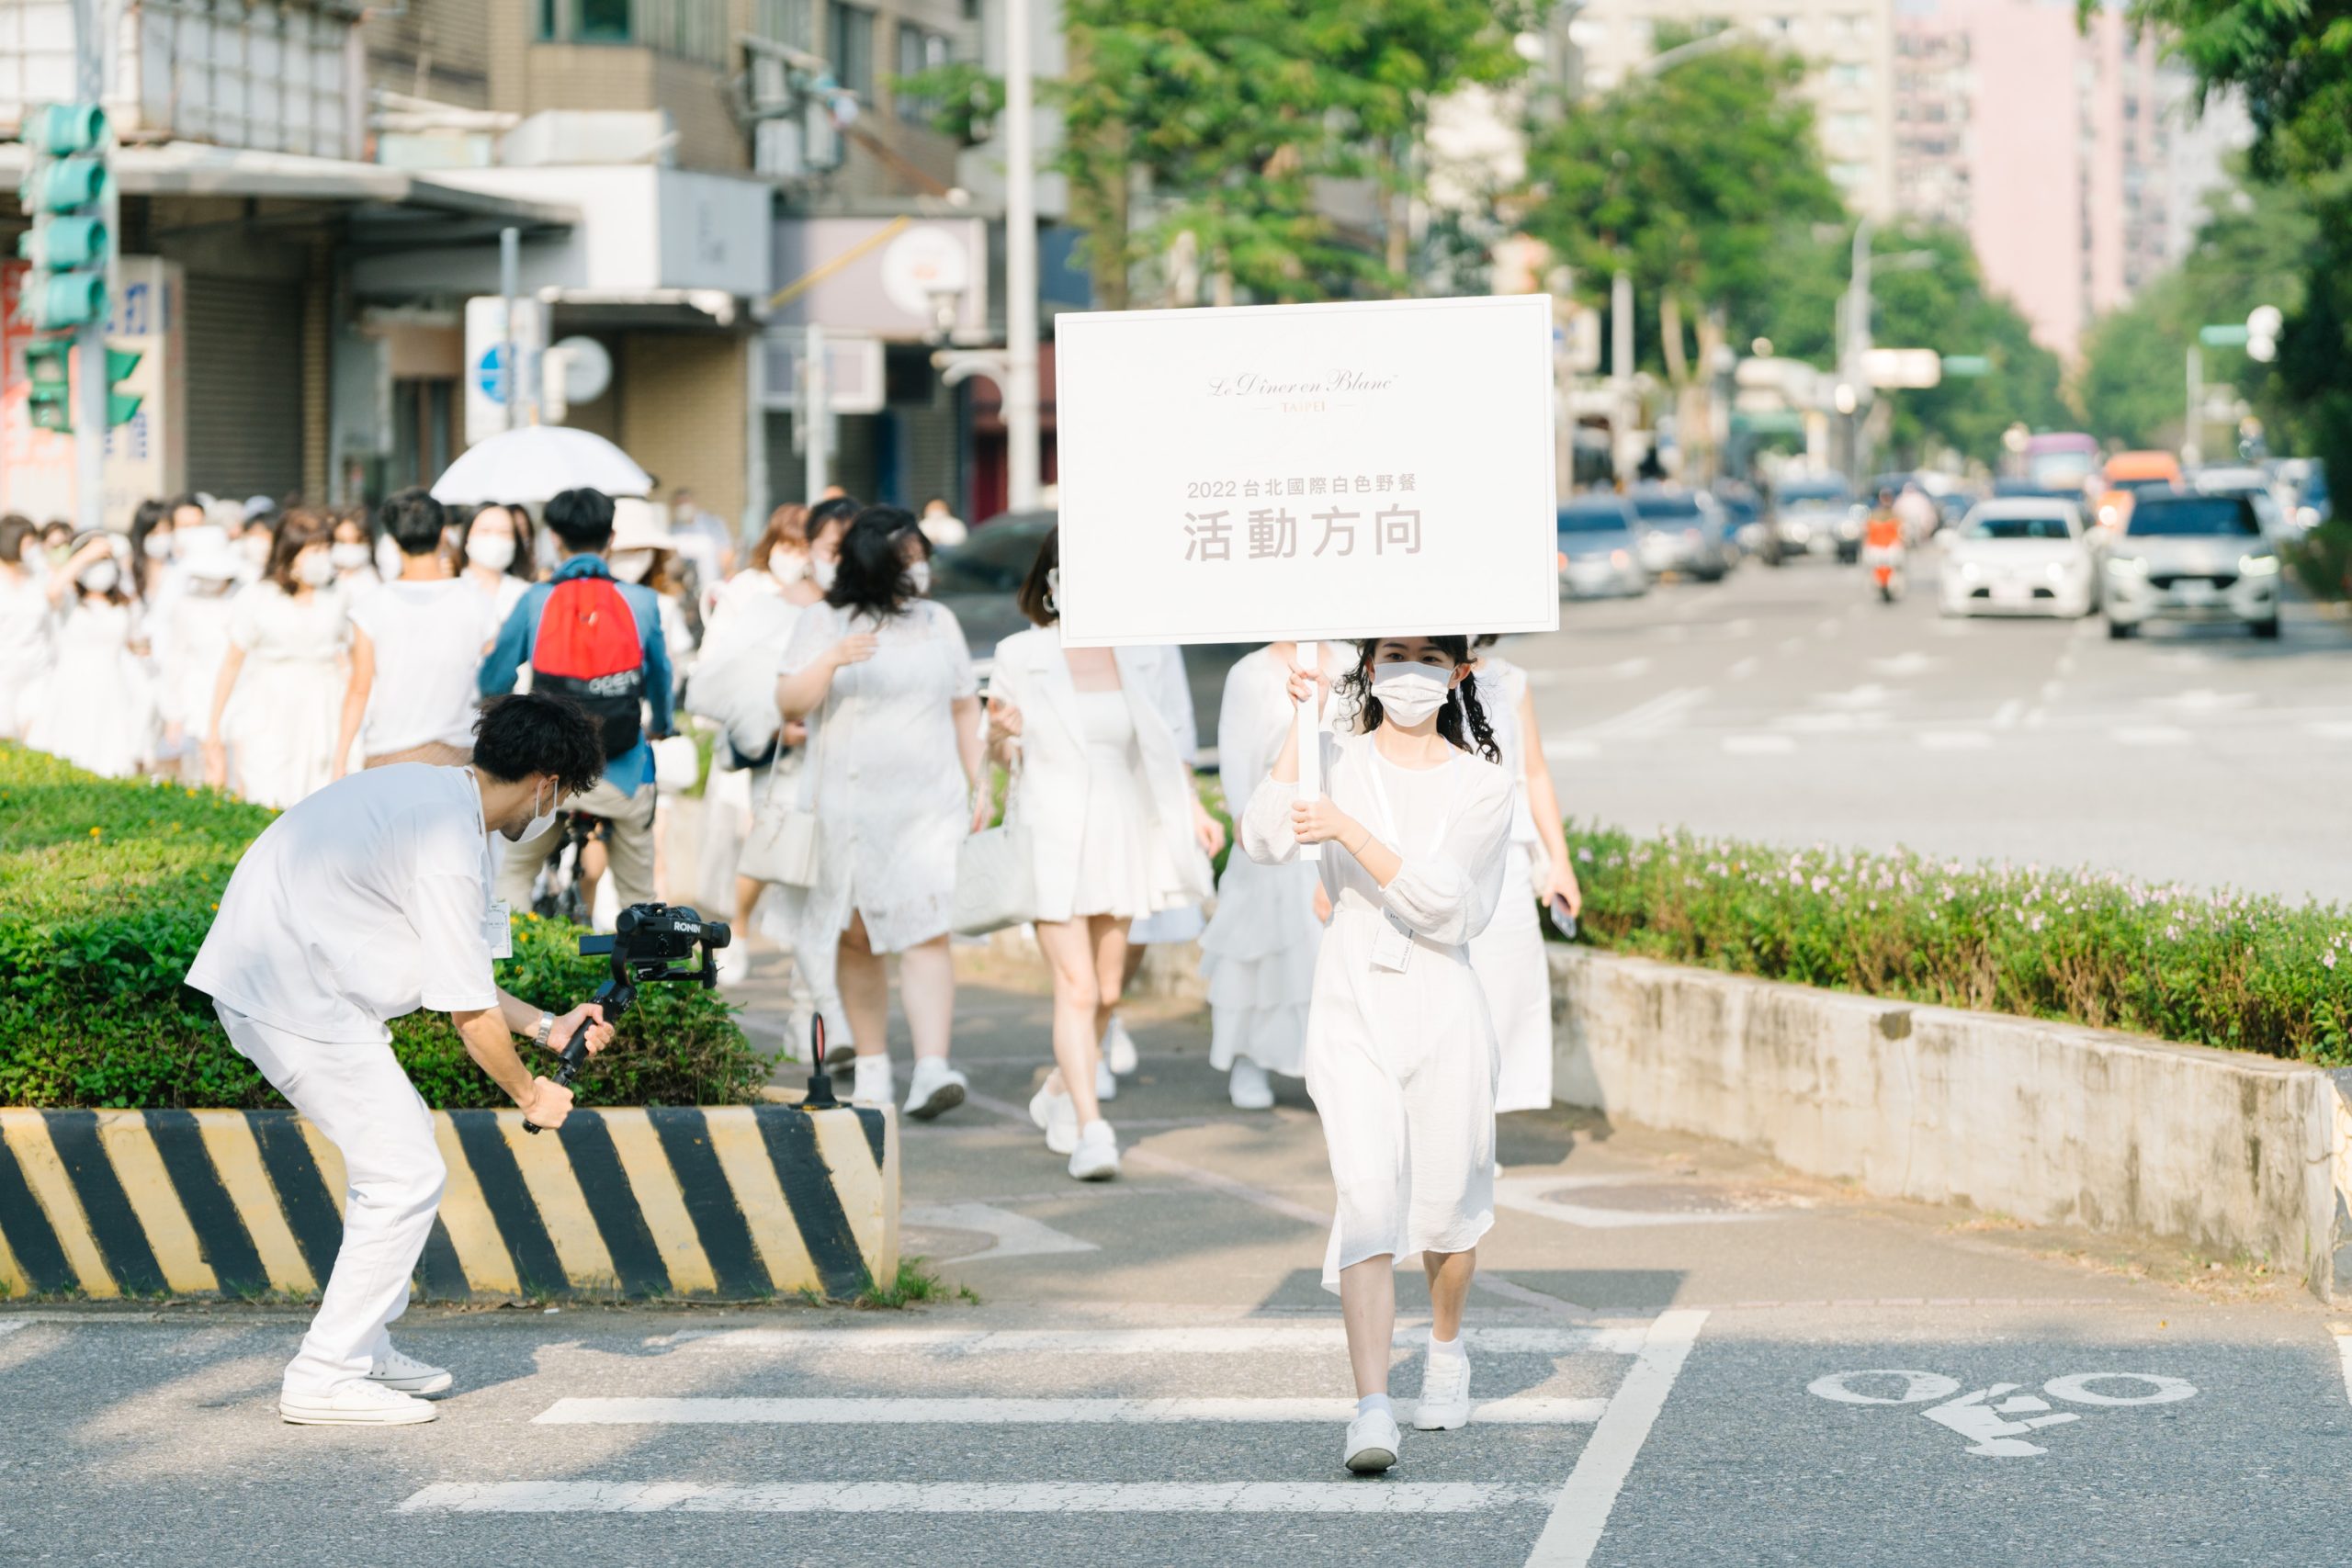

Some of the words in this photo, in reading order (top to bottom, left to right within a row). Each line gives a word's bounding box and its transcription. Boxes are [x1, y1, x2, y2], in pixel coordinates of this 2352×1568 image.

[1206, 376, 1232, 397] Le
[1236, 371, 1297, 396] Dîner
[1300, 381, 1321, 393] en
[1281, 400, 1326, 412] TAIPEI
[1183, 502, 1421, 562] 活動方向
[673, 920, 701, 934] RONIN
